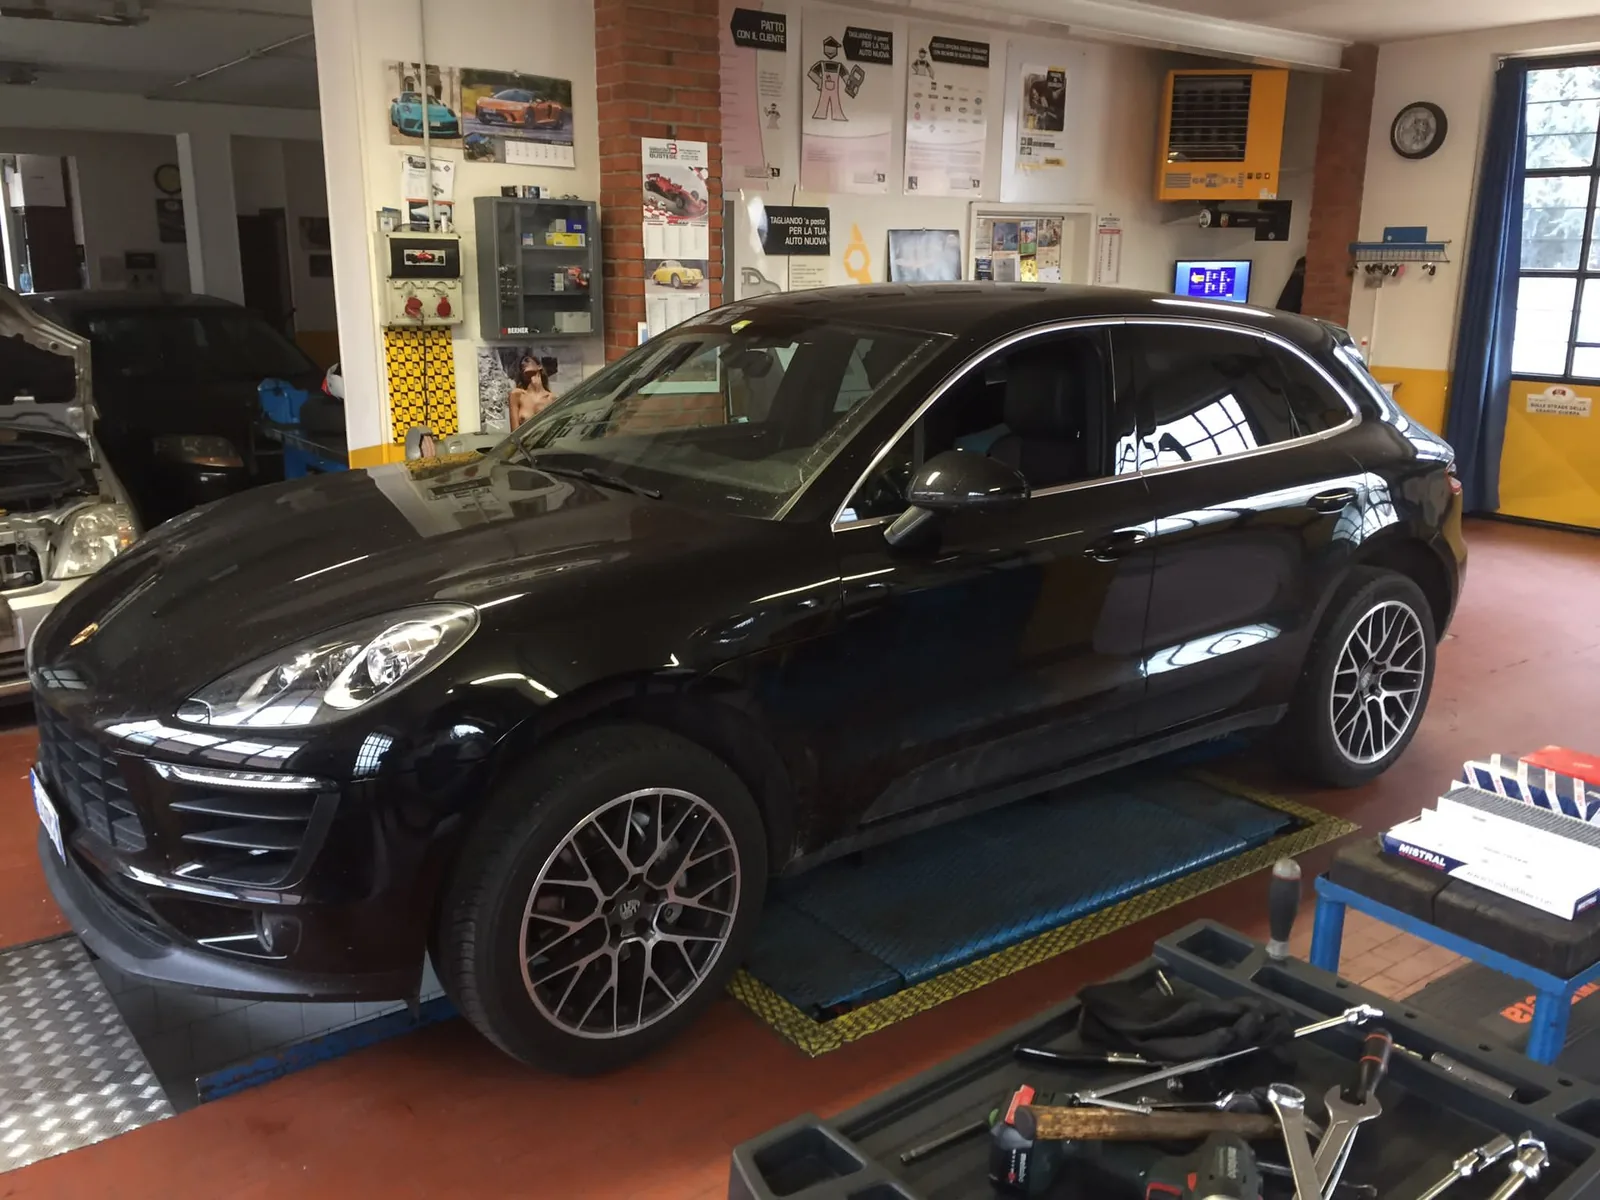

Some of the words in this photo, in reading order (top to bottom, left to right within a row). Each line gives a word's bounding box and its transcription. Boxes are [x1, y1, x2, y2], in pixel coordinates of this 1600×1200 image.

[760, 20, 785, 33] PATTO
[736, 30, 751, 40] CON
[752, 31, 758, 41] IL
[759, 32, 785, 44] CLIENTE
[770, 216, 803, 225] TAGLIANDO
[788, 226, 802, 235] PER
[803, 226, 812, 235] LA
[813, 226, 827, 235] TUA
[784, 236, 803, 245] AUTO
[804, 236, 827, 245] NUOVA
[1398, 843, 1446, 868] MISTRAL
